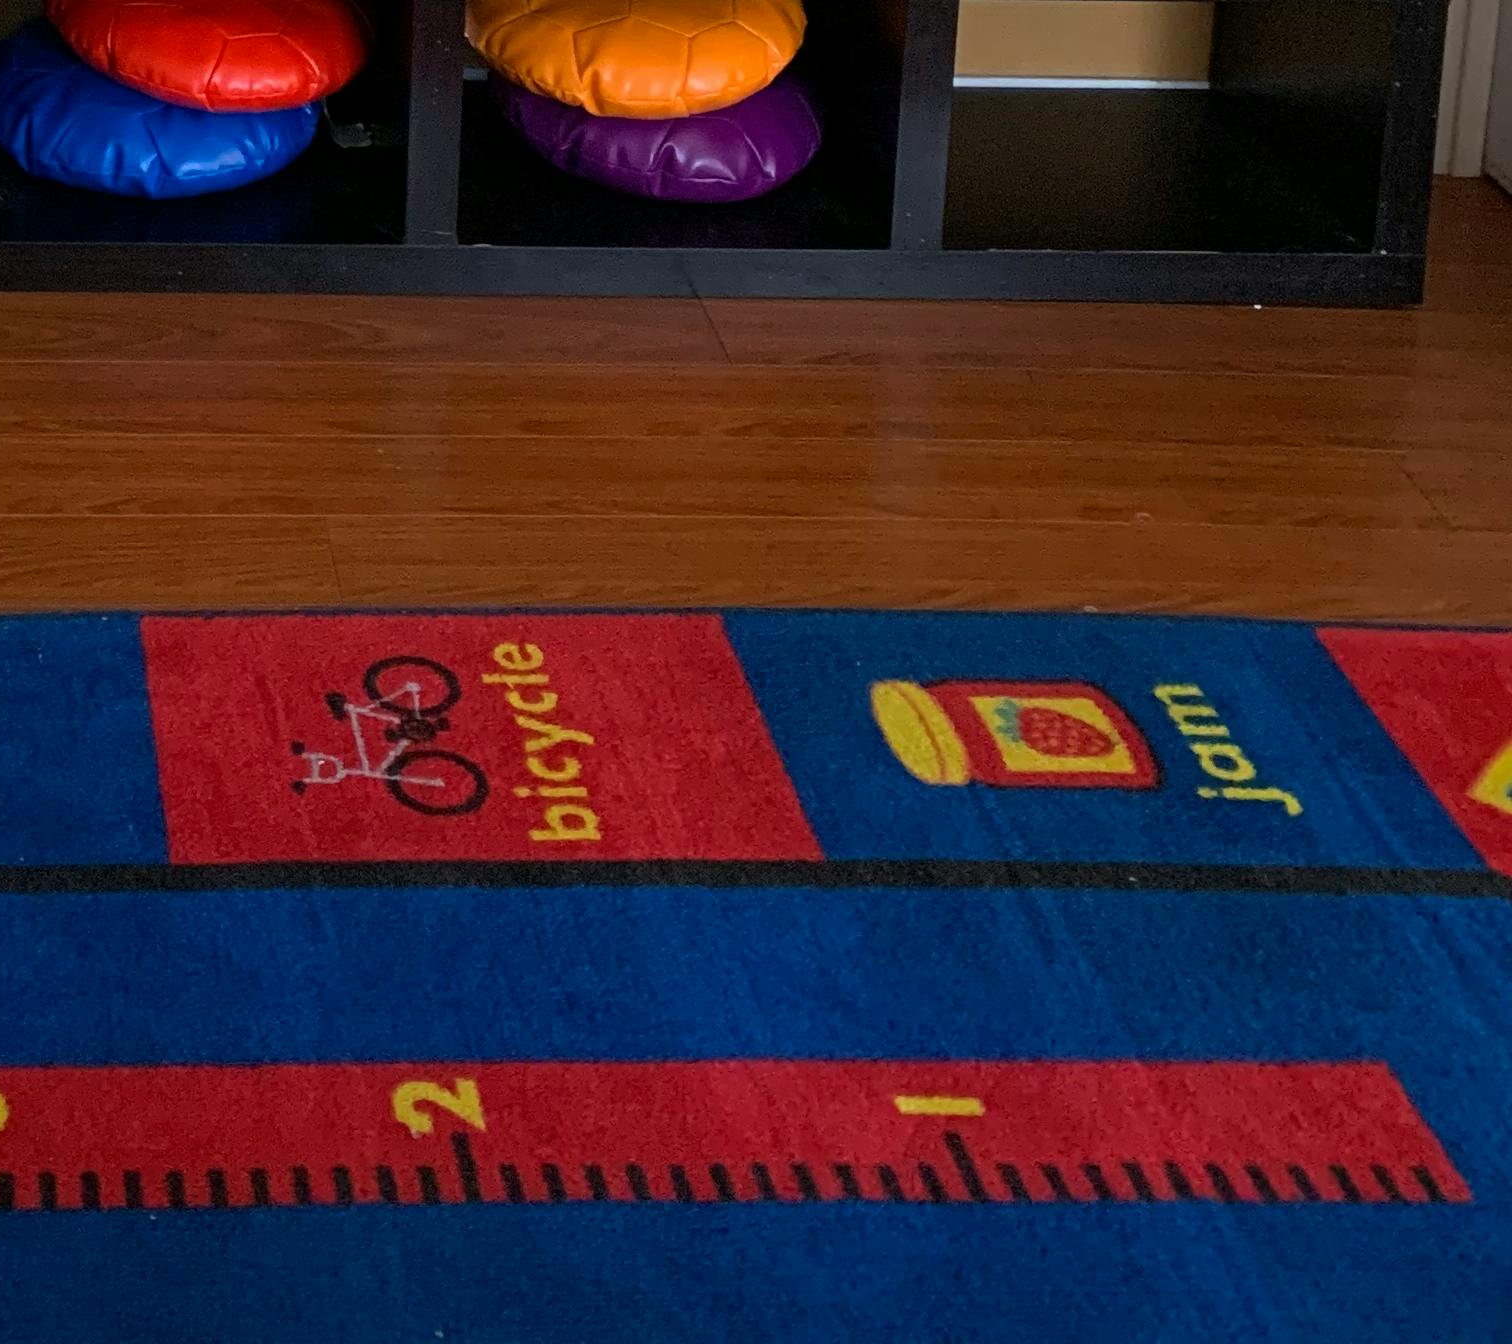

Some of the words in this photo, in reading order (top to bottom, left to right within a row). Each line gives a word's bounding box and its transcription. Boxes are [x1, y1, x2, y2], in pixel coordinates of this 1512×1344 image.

[483, 642, 600, 842] bicycle
[1152, 684, 1303, 816] jam
[394, 1079, 484, 1137] 2
